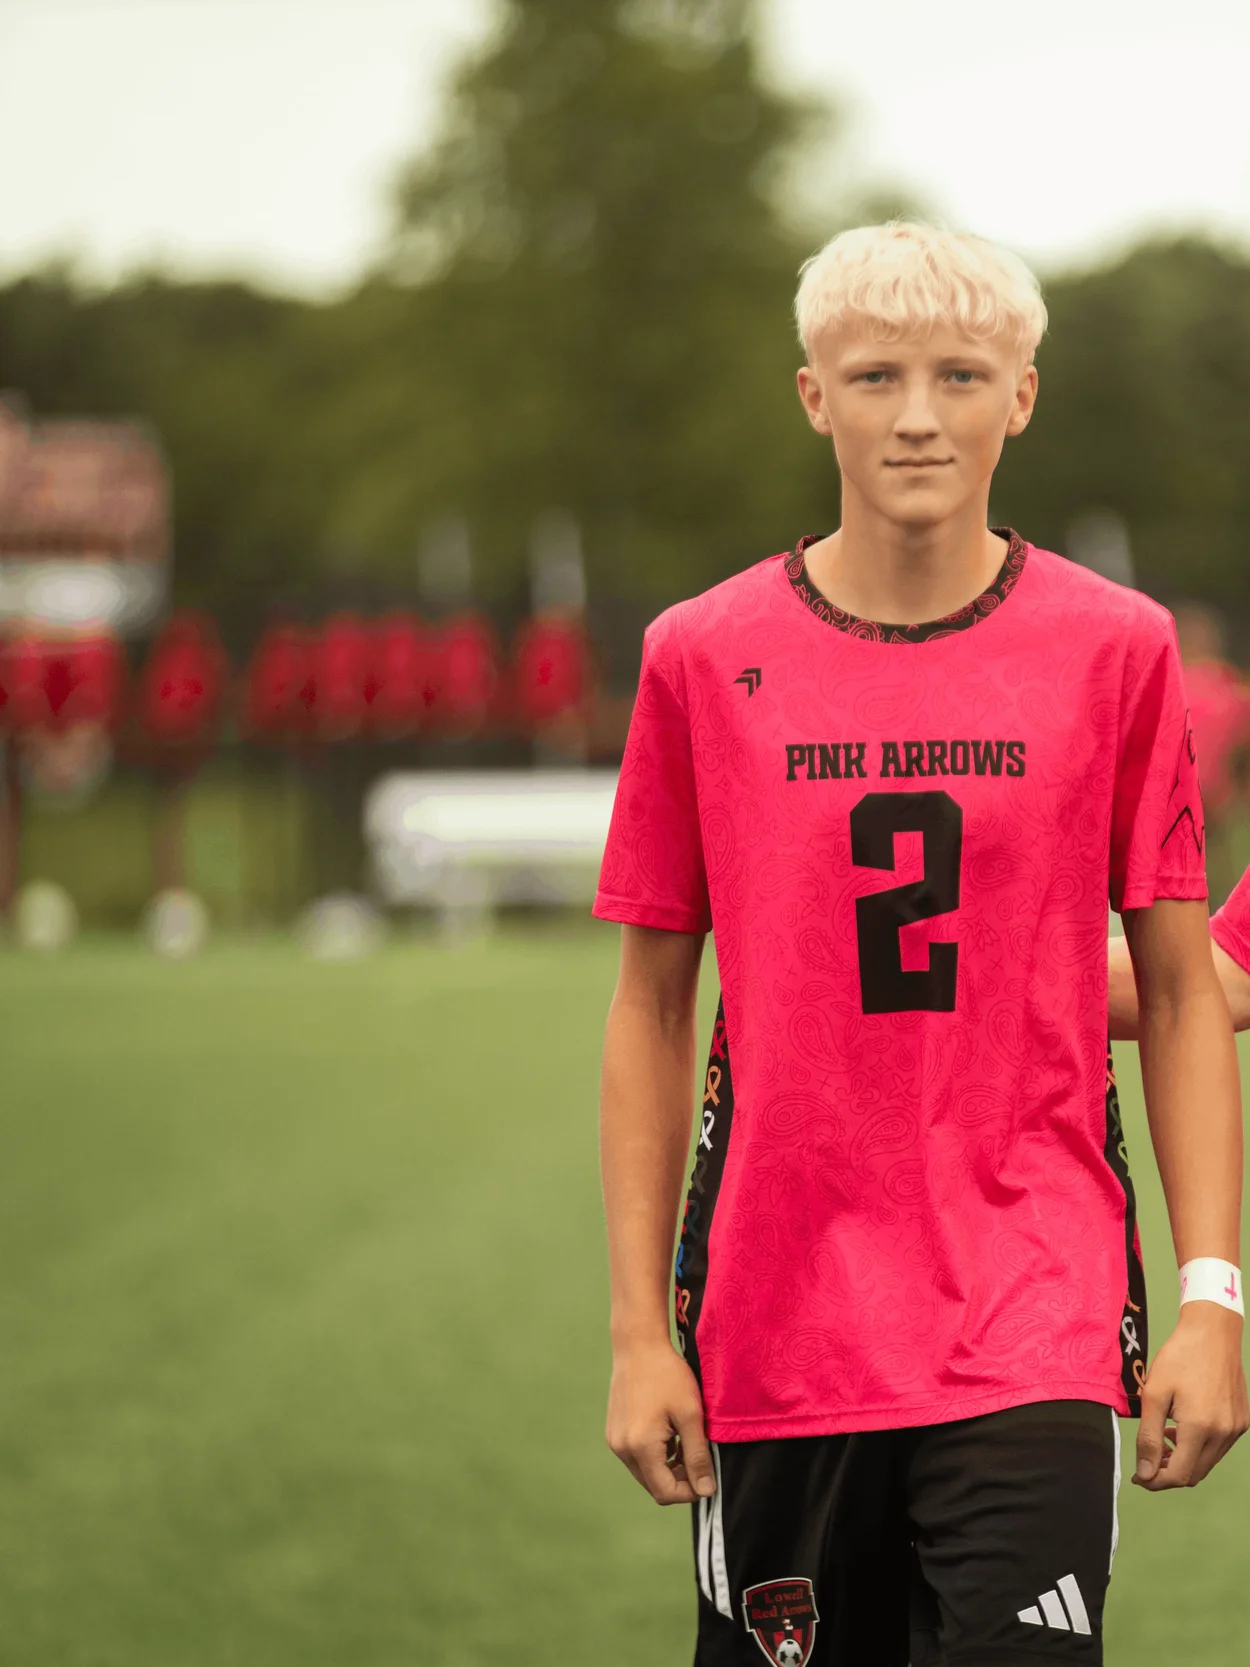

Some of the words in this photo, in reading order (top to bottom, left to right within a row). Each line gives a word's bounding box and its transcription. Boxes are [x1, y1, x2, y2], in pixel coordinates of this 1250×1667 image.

[785, 742, 867, 781] PINK
[880, 740, 1026, 777] ARROWS
[850, 790, 963, 1015] 2
[764, 1588, 804, 1604] Lowell
[752, 1605, 778, 1619] Red
